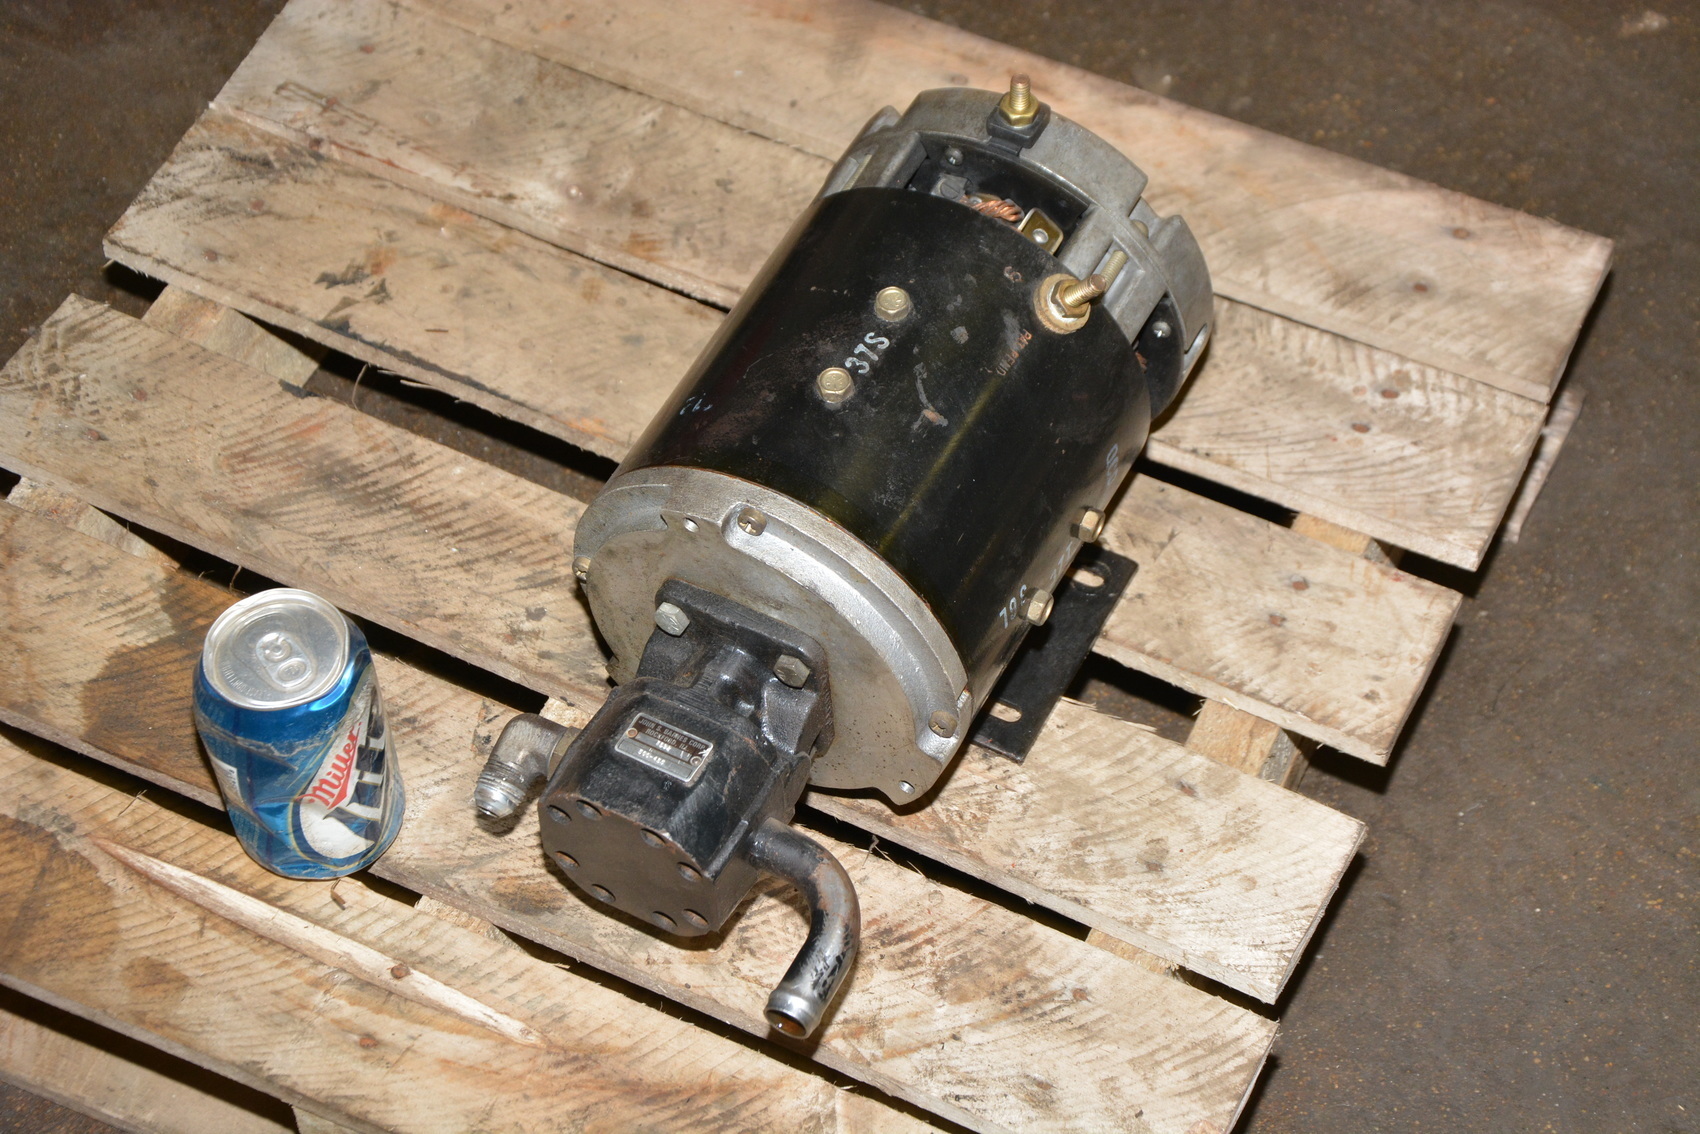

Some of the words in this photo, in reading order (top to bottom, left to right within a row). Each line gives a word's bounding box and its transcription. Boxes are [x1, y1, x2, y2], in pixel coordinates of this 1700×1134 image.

[844, 331, 891, 374] 37S
[638, 719, 653, 729] JOHN
[664, 727, 688, 742] BARNES
[294, 721, 363, 811] Miller
